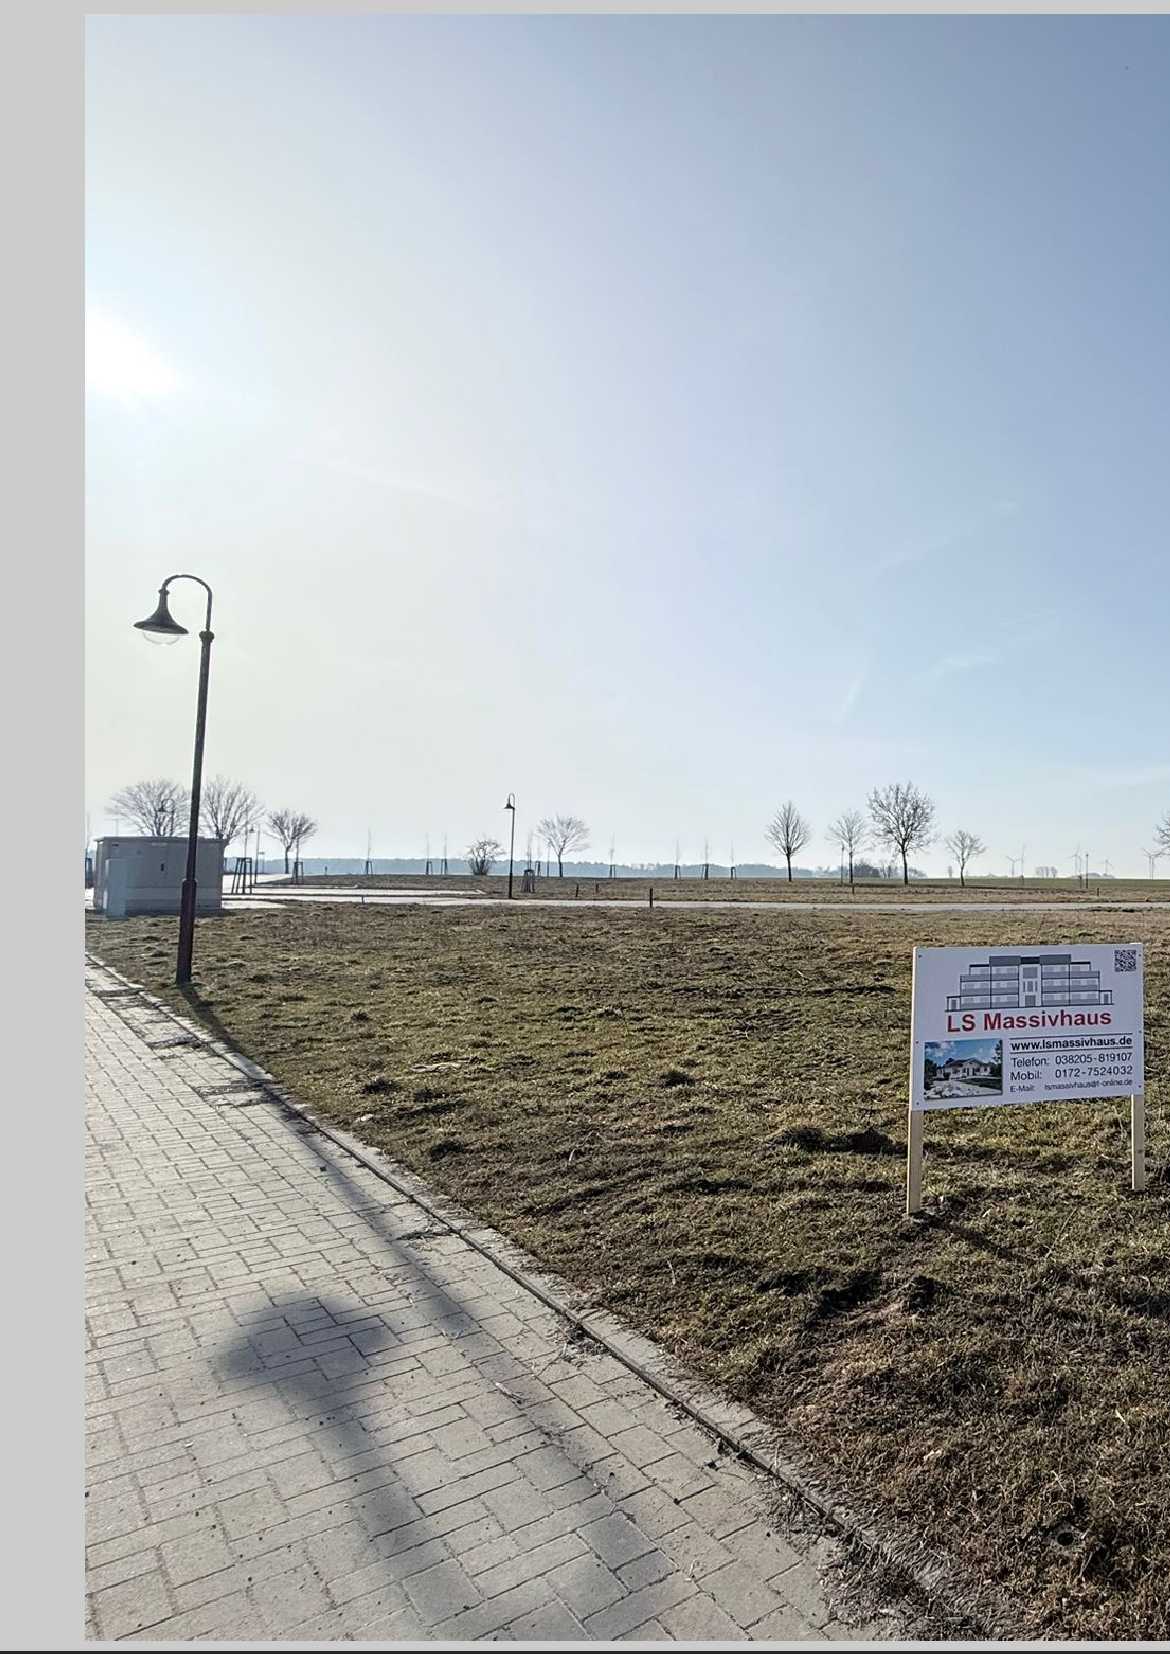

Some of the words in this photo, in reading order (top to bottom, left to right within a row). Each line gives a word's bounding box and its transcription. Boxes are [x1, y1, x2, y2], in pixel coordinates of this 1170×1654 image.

[947, 1013, 975, 1033] LS
[984, 1009, 1112, 1031] Massivhaus
[1011, 1036, 1132, 1051] www.lsmassivhaus.de
[1011, 1057, 1049, 1068] Telefon:
[1010, 1070, 1042, 1081] Mobil:
